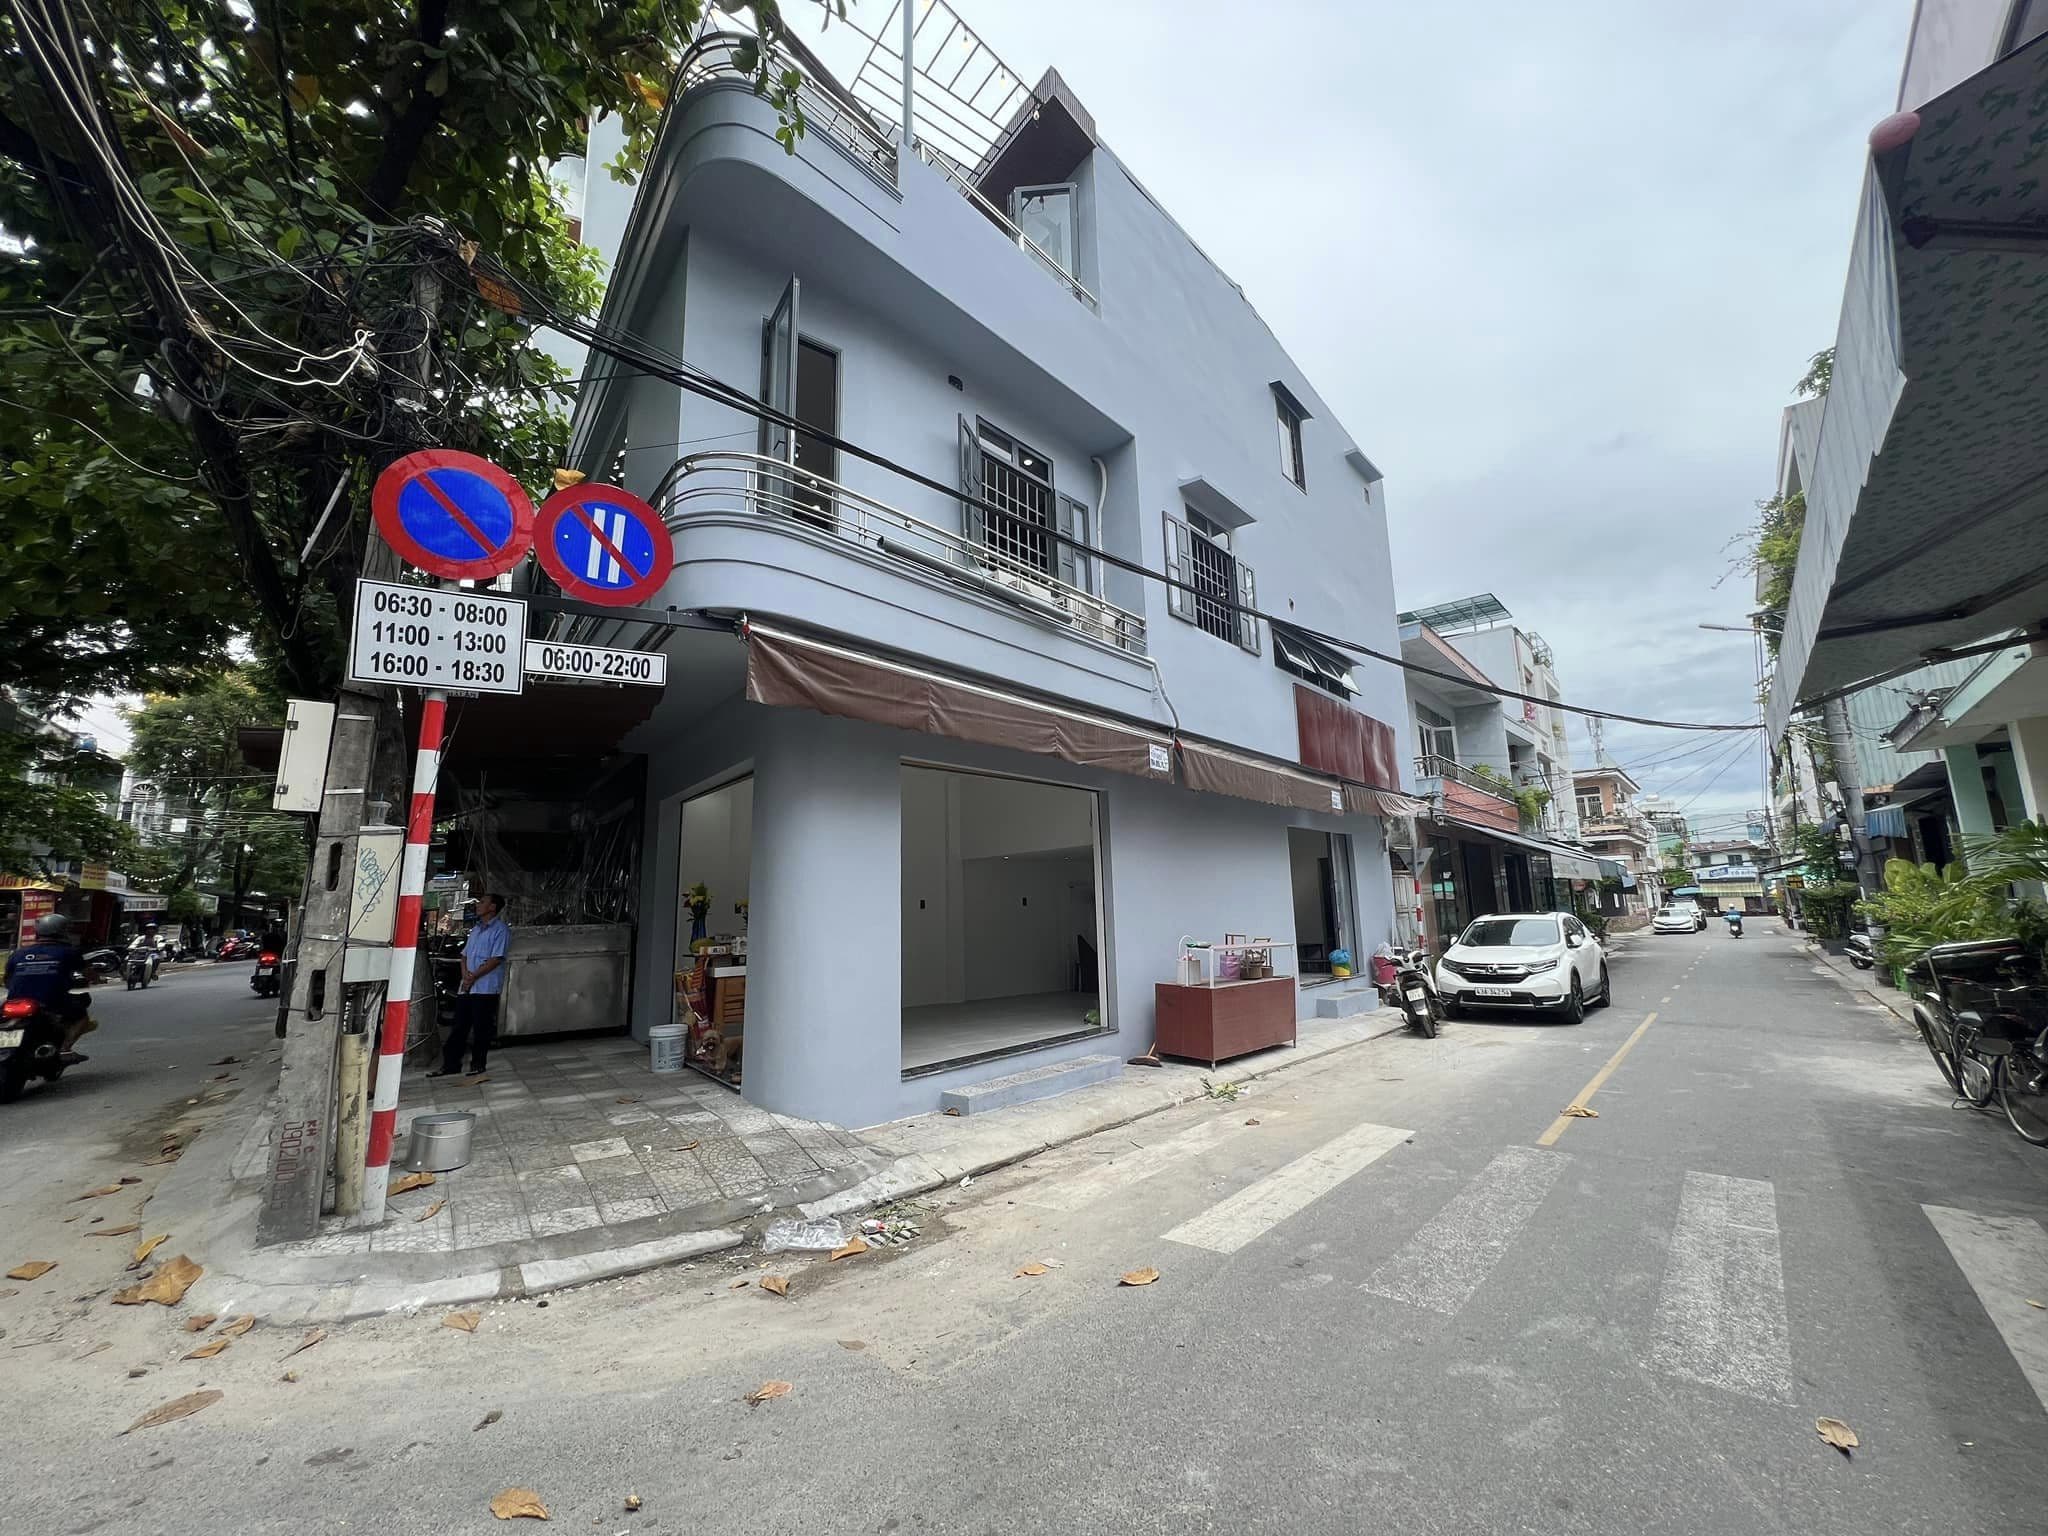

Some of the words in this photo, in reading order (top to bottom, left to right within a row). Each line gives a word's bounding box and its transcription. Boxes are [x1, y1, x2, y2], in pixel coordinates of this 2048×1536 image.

[374, 591, 432, 618] 06:30
[454, 602, 507, 626] 08:00
[372, 621, 430, 646] 11:00
[453, 630, 506, 654] 13:00
[370, 651, 428, 676] 16:00
[451, 660, 505, 683] 18:30
[542, 647, 651, 680] 06:00-22:00
